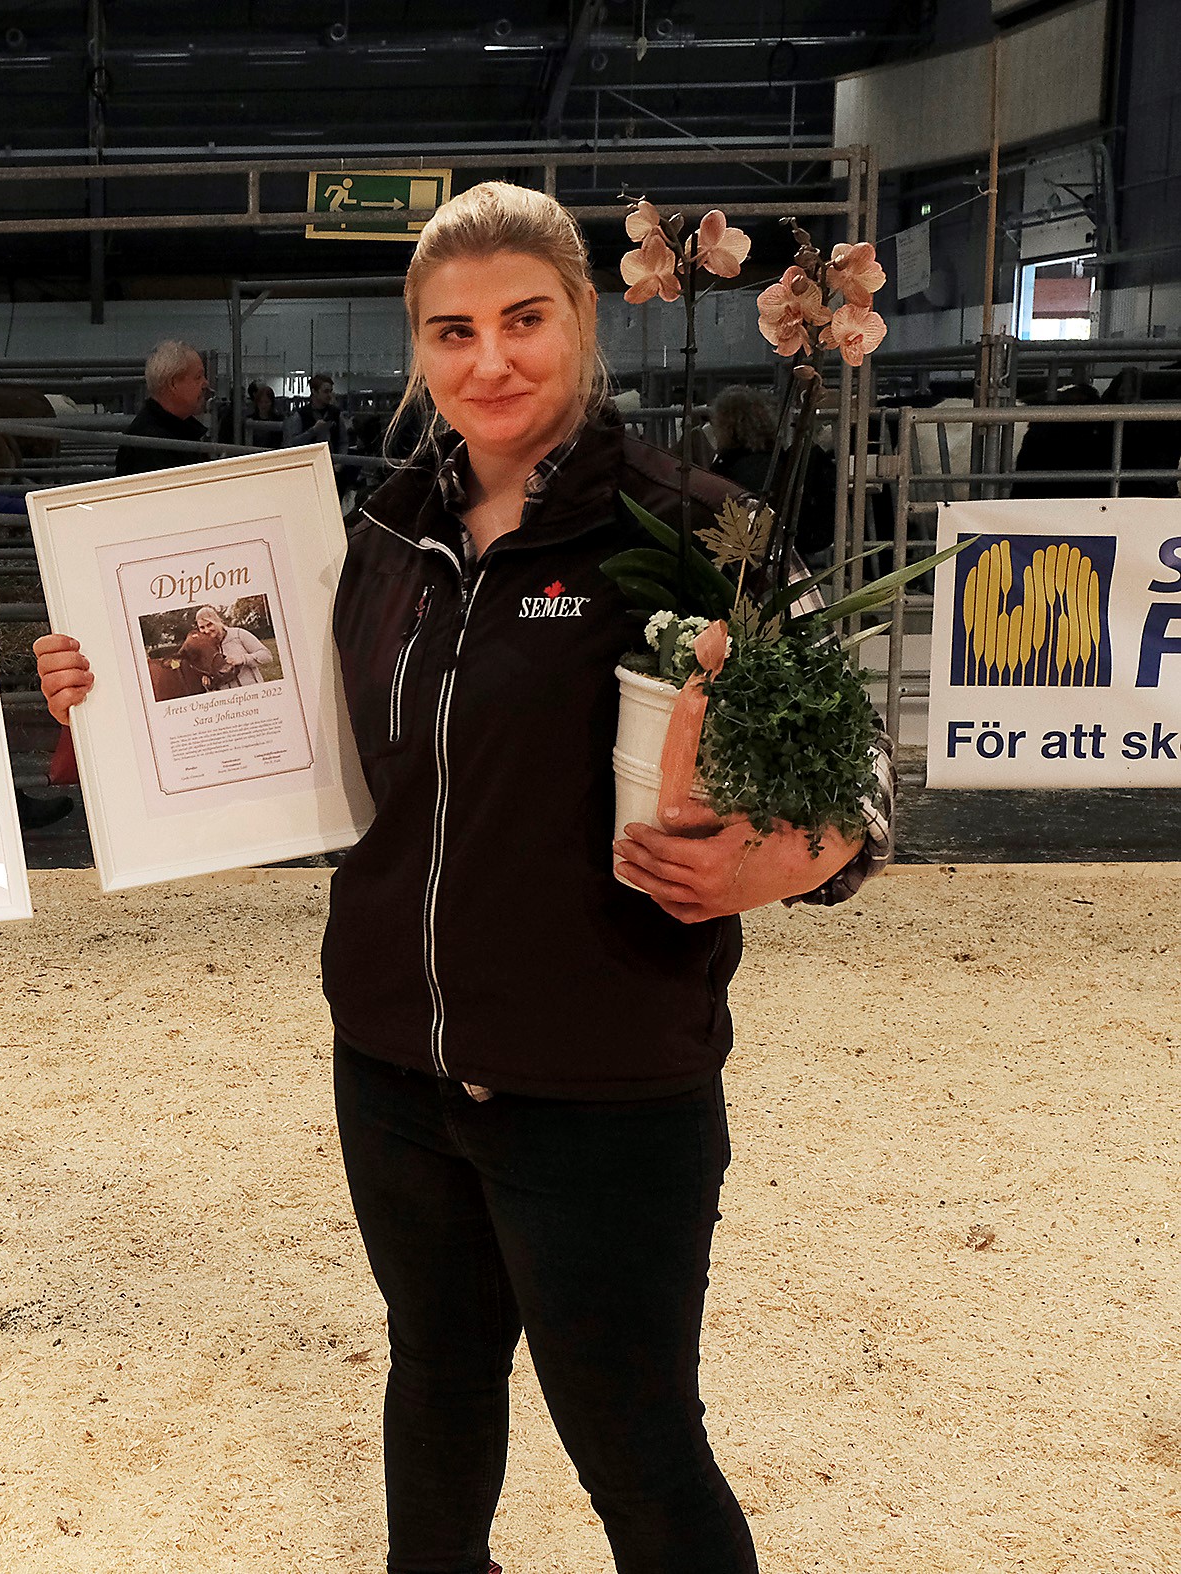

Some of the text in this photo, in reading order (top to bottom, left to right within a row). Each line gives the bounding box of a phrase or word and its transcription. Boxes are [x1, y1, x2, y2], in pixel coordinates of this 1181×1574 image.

[150, 562, 251, 603] Diplom
[518, 596, 587, 618] SEMEX
[163, 686, 283, 718] Årets Ungdomsdiplom 2022
[193, 707, 260, 727] Sara Johansson
[946, 720, 1181, 760] För att sk
